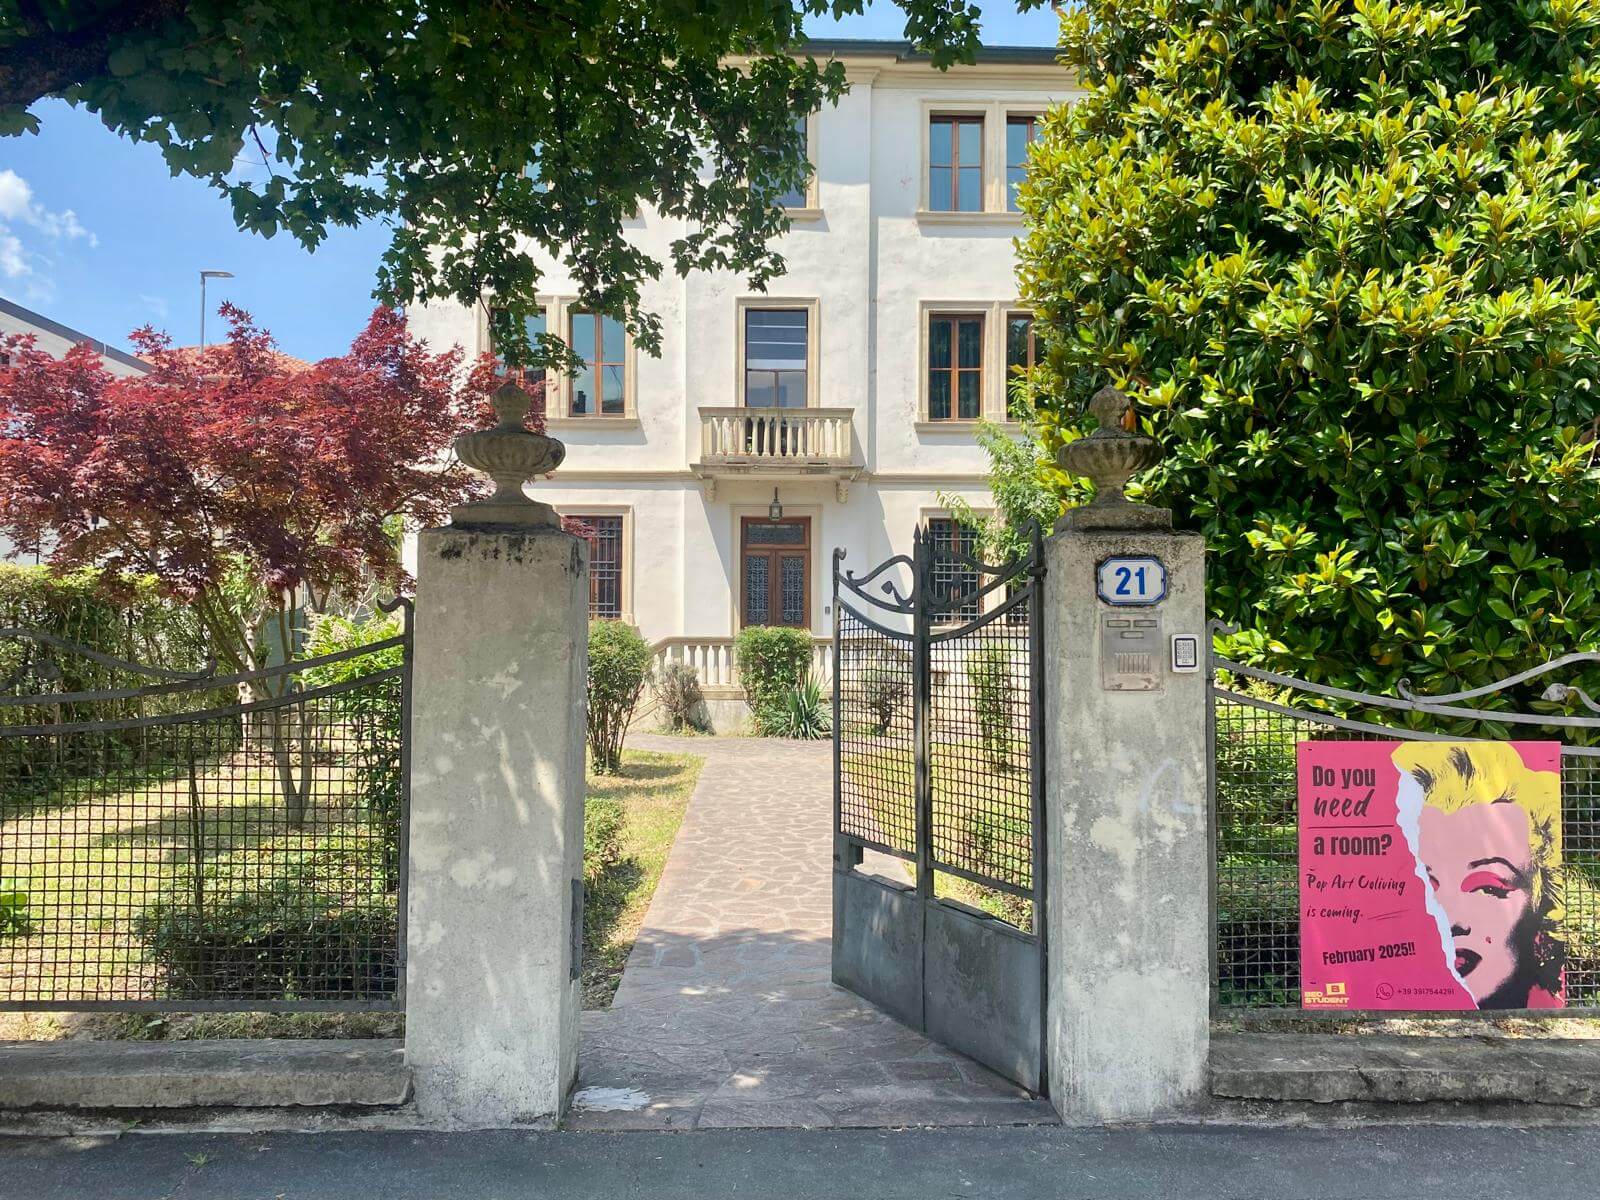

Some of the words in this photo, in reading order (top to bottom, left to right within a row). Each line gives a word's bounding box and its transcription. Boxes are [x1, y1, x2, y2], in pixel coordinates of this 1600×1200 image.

[1115, 567, 1146, 595] 21
[1312, 765, 1335, 787] Do
[1341, 768, 1376, 789] you
[1313, 789, 1375, 817] need
[1313, 836, 1325, 855] a
[1330, 834, 1392, 855] room?
[1306, 873, 1328, 892] Pop
[1331, 874, 1354, 889] Art
[1358, 875, 1406, 896] Coliving
[1306, 905, 1316, 917] is
[1320, 906, 1363, 924] coming.
[1322, 948, 1375, 965] February
[1379, 942, 1416, 959] 2025!!
[1397, 988, 1412, 996] +39
